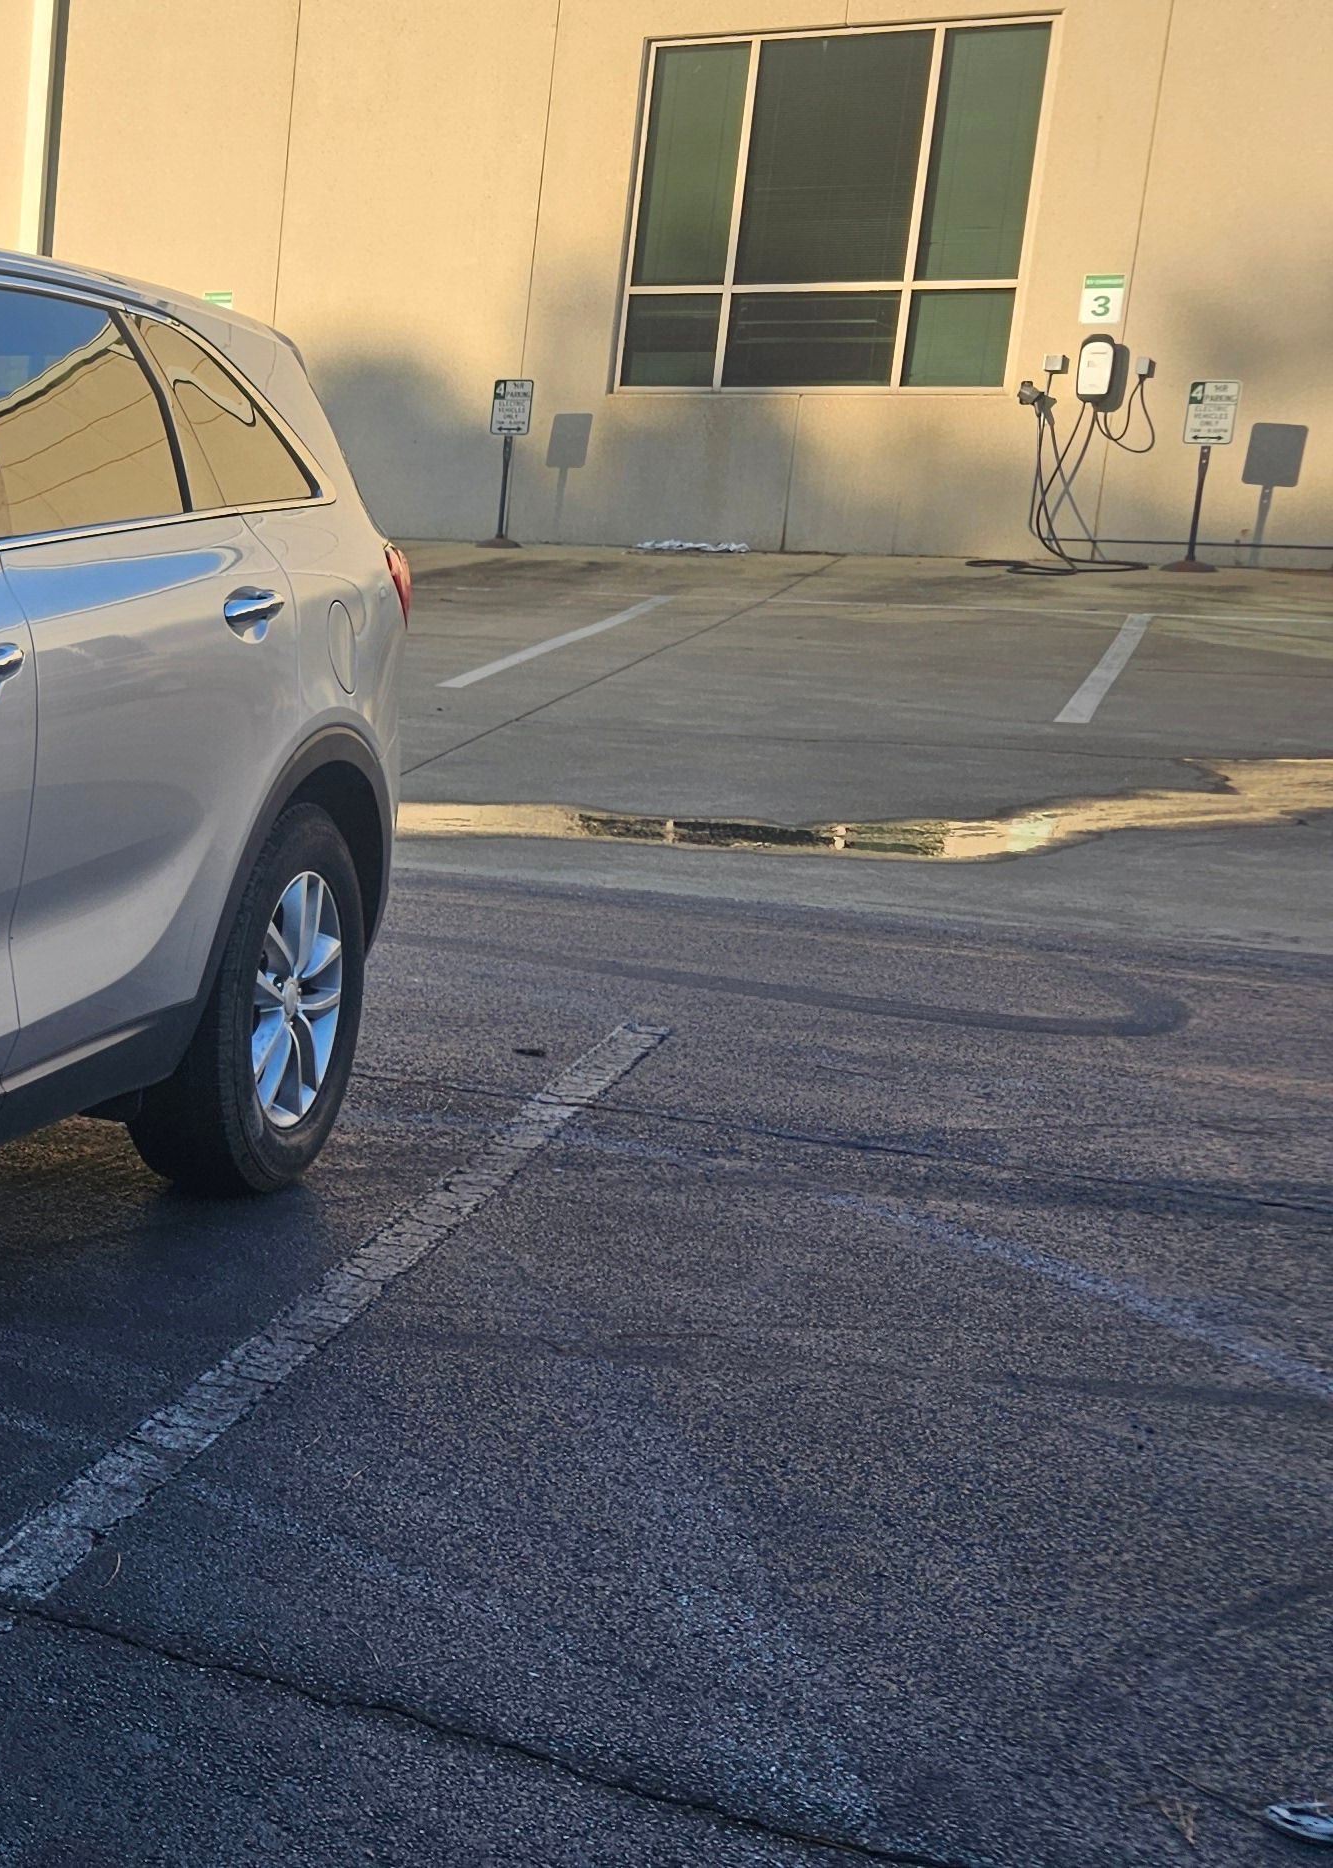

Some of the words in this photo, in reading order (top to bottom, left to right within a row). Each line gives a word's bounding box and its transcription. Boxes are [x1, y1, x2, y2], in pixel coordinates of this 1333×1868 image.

[1091, 295, 1111, 317] 3
[495, 382, 505, 396] 4
[1191, 384, 1204, 401] 4
[1204, 394, 1238, 402] PARKING
